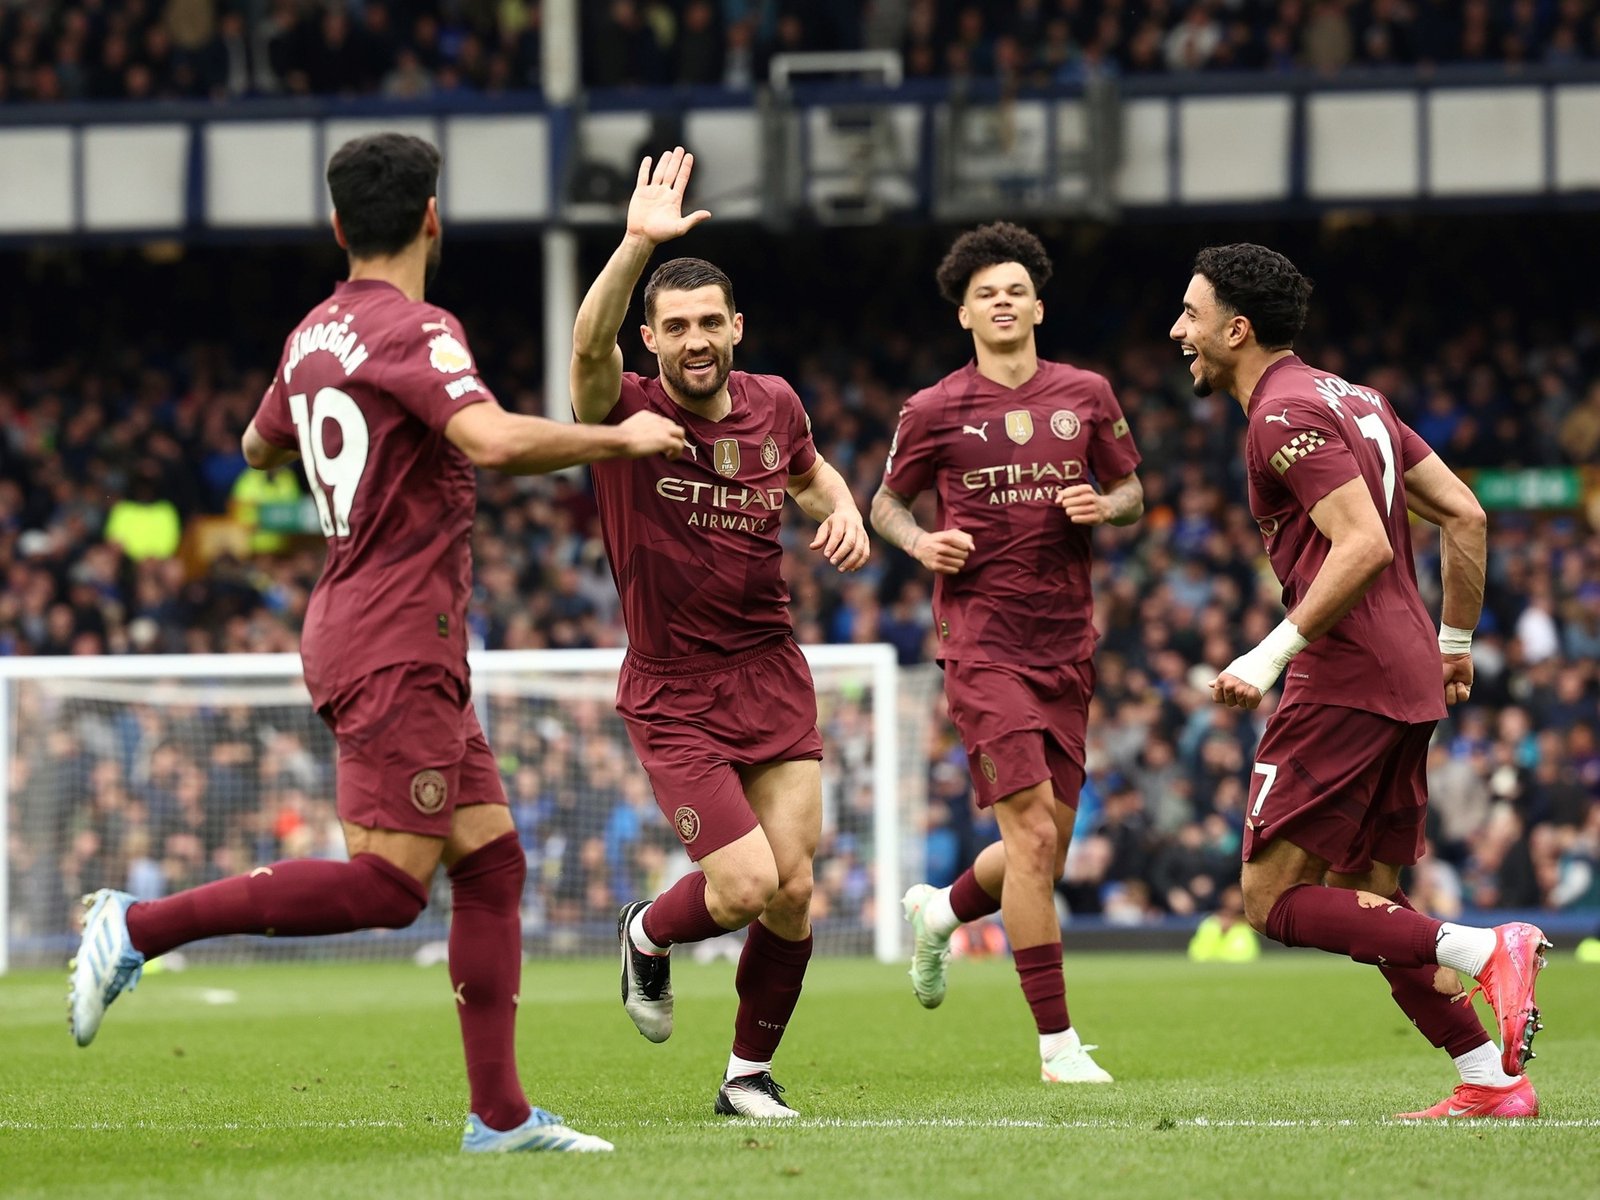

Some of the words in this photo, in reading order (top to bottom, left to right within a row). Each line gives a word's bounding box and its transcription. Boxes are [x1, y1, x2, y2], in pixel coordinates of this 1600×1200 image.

[288, 386, 369, 538] 19
[962, 460, 1083, 490] ETIHAD
[1353, 412, 1396, 518] 7
[655, 477, 785, 511] ETIHAD
[687, 511, 768, 532] AIRWAYS
[1251, 762, 1278, 817] 7
